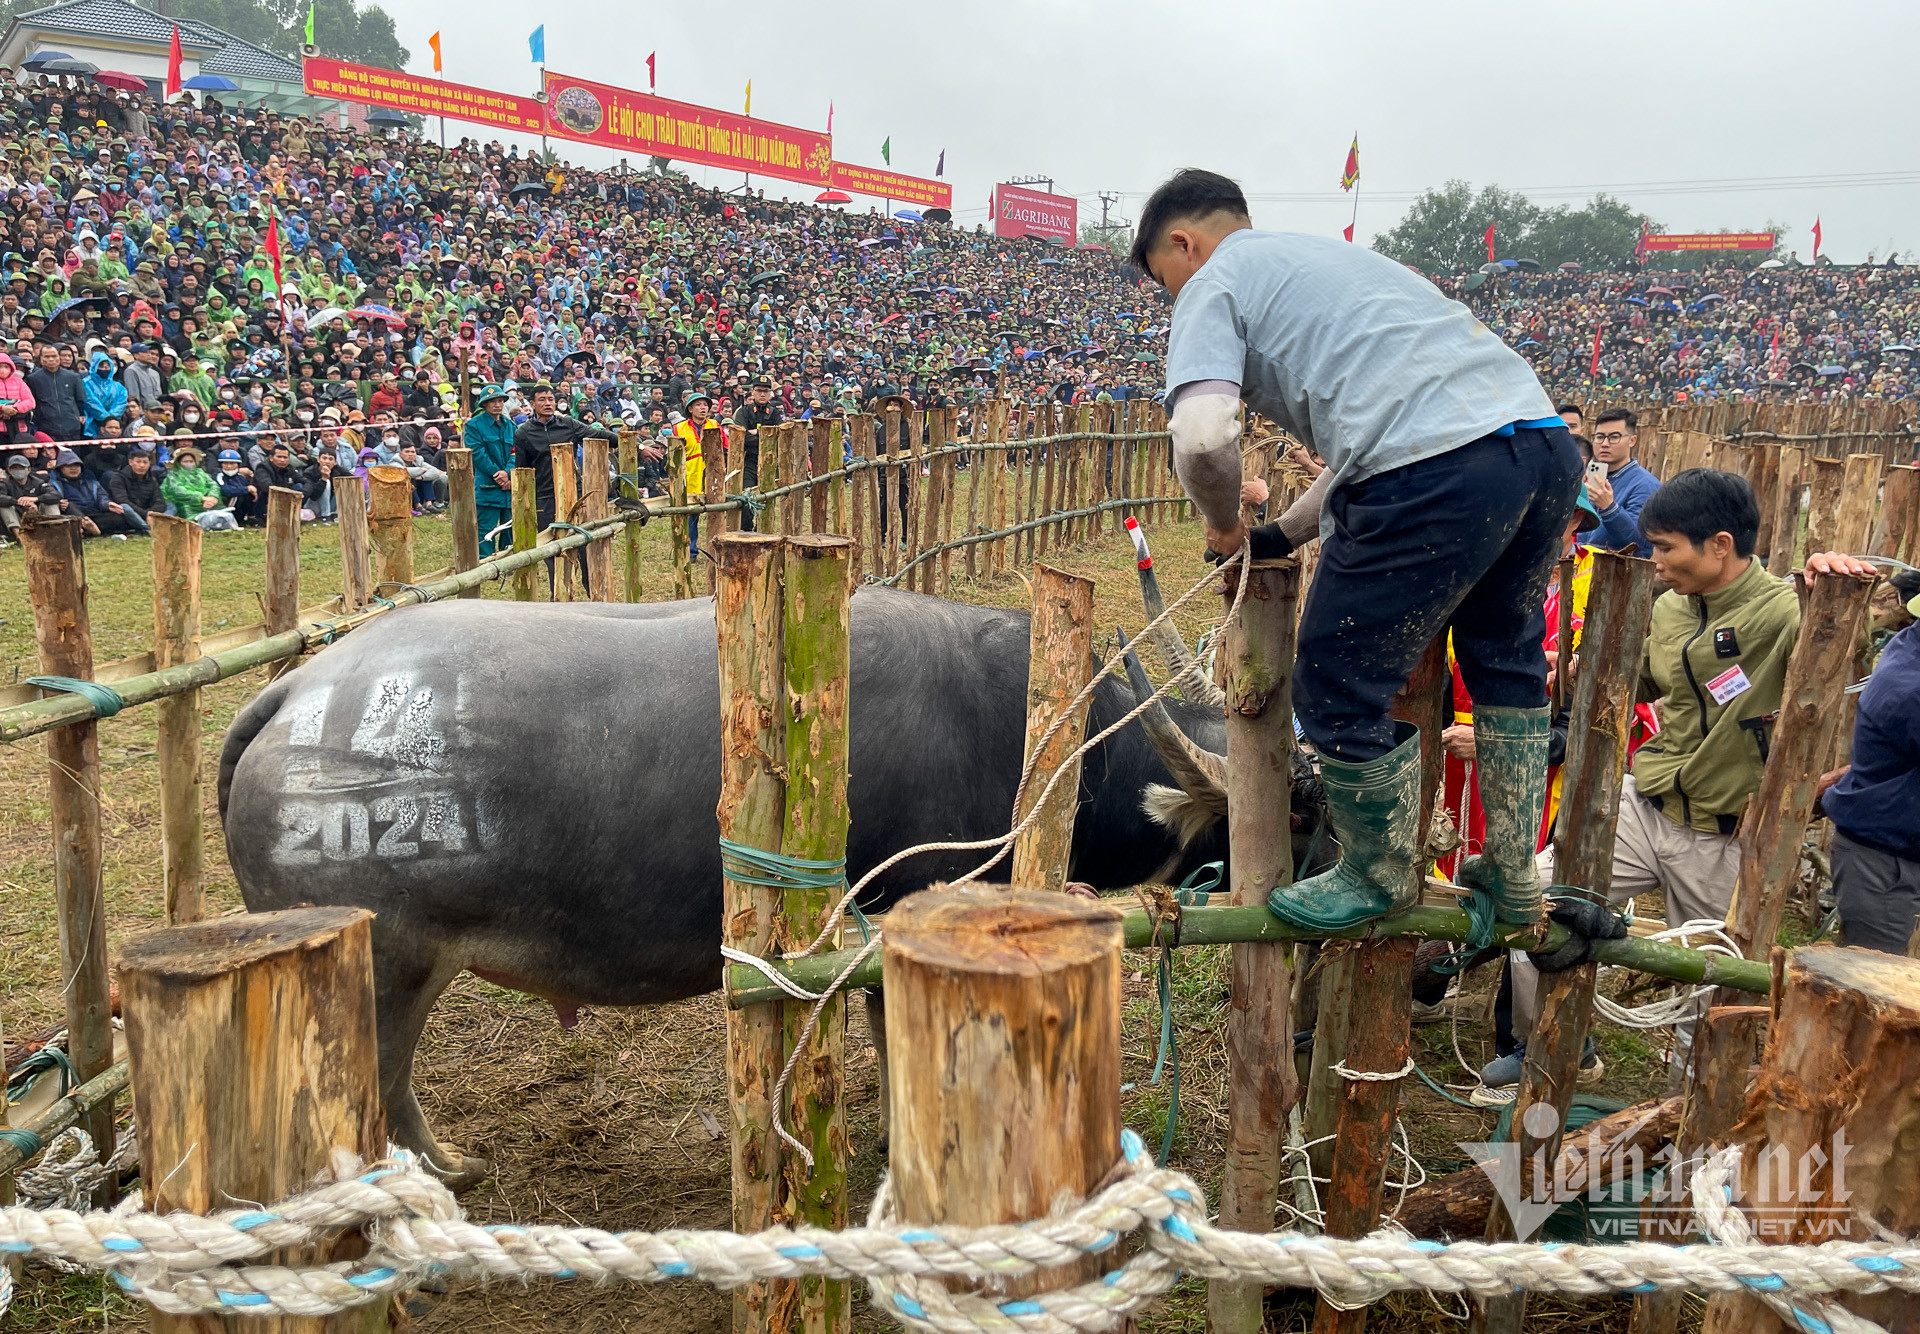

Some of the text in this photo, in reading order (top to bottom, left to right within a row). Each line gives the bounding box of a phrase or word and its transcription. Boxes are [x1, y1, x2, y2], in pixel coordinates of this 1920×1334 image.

[359, 72, 368, 84] BỘ
[608, 95, 618, 134] LỄ
[620, 102, 634, 143] HỘI
[636, 111, 654, 147] CHỌI
[656, 111, 676, 145] TRÂU
[677, 115, 705, 151] TRUYỀN
[707, 119, 730, 156] THỐNG
[731, 127, 741, 158] XÃ
[743, 126, 754, 160] HẢI
[769, 135, 785, 166] NĂM
[786, 143, 801, 169] 2024
[1014, 208, 1071, 229] AGRIBANK
[270, 798, 468, 866] 2024
